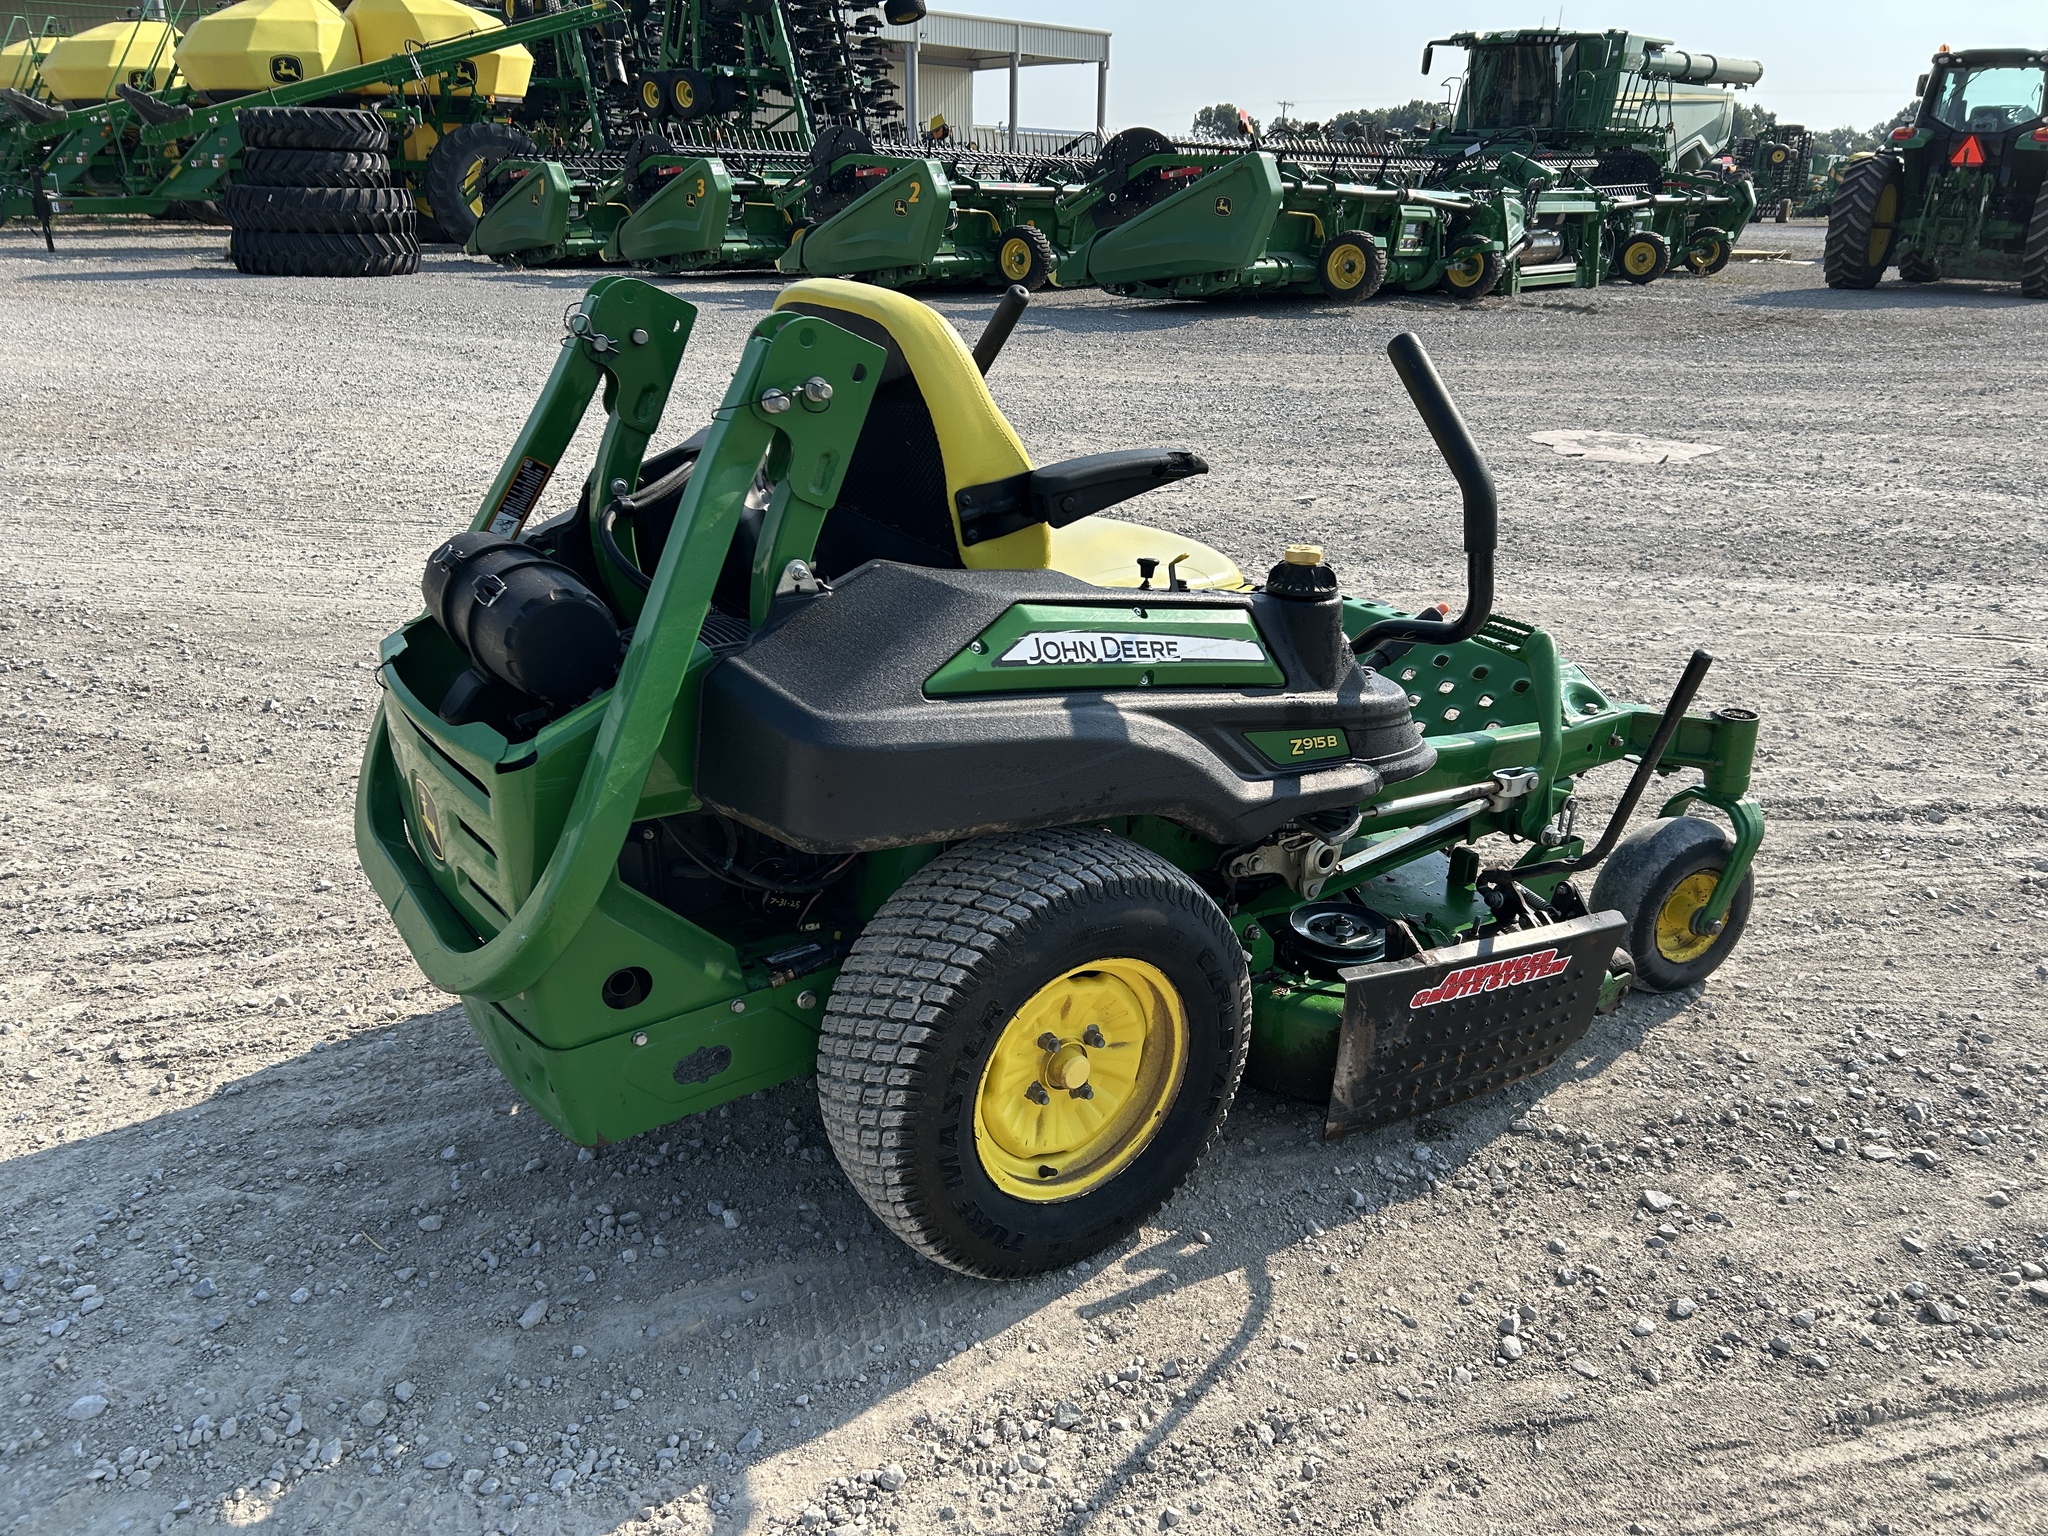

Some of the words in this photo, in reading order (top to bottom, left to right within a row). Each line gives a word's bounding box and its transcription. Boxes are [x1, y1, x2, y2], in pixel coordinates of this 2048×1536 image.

[538, 179, 545, 195] 1
[696, 179, 705, 198] 3
[908, 181, 921, 203] 2
[1029, 637, 1098, 661] JOHN
[1100, 636, 1180, 659] DEERE
[770, 897, 801, 909] 7-31-25
[1441, 951, 1556, 986] ADVANCED
[1411, 979, 1485, 1006] CHUTE
[1486, 958, 1569, 989] SYSTEM
[938, 998, 1005, 1191] MASTER
[949, 1199, 1026, 1254] TURF
